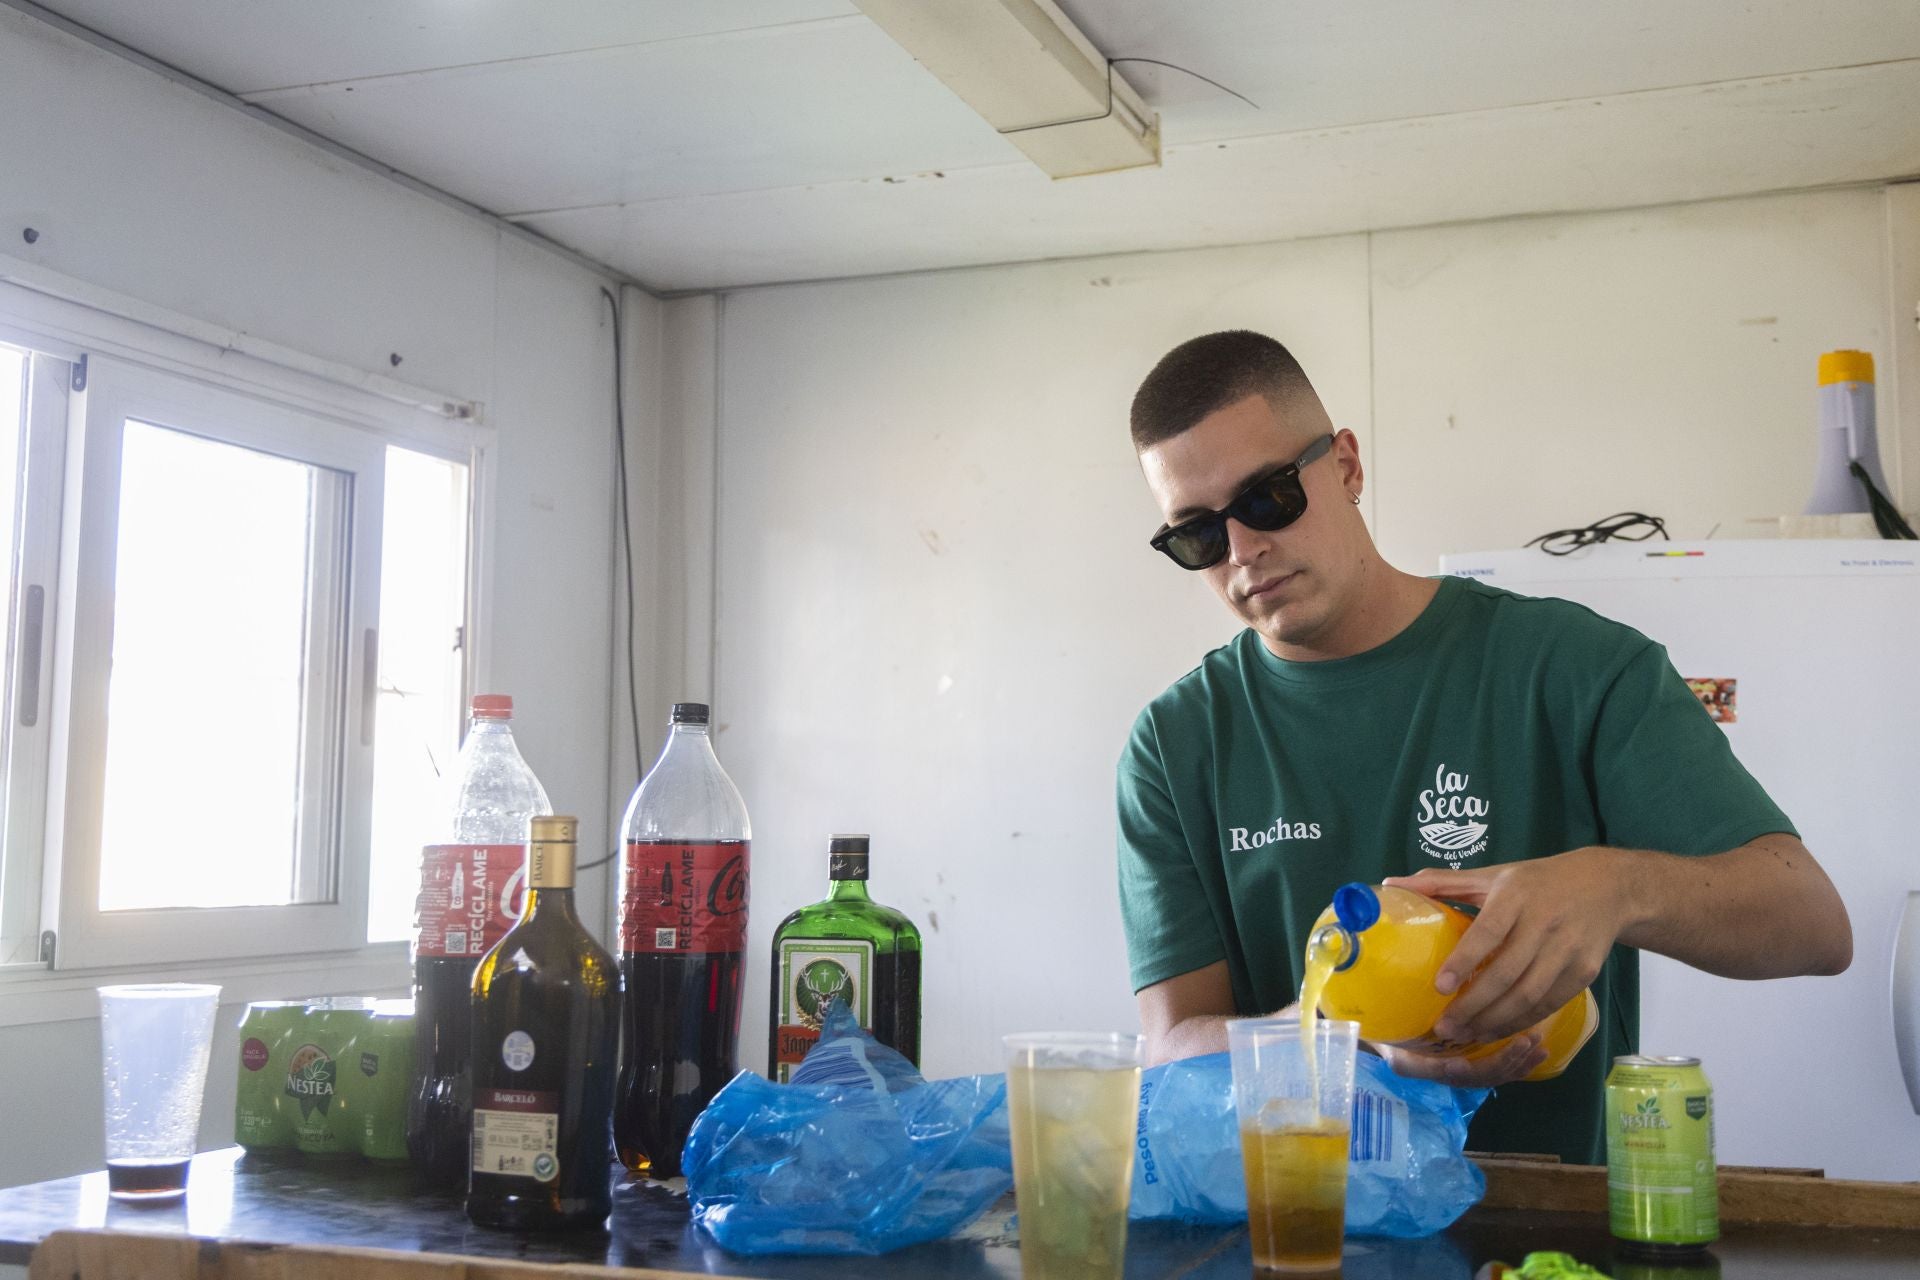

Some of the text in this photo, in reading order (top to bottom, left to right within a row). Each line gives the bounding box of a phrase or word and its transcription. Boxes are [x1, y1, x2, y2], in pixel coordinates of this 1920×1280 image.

[1435, 763, 1469, 795] la
[1417, 789, 1490, 823] Seca
[1228, 817, 1322, 852] Rochas
[1420, 839, 1488, 861] Cuna del Verdejo
[467, 849, 488, 954] RECÍCLAME
[676, 849, 695, 950] RECÍCLAME
[287, 1074, 334, 1096] NESTEA
[493, 1091, 536, 1104] BARCELÓ
[1619, 1112, 1669, 1130] NESTEA
[1137, 1137, 1159, 1186] Peso
